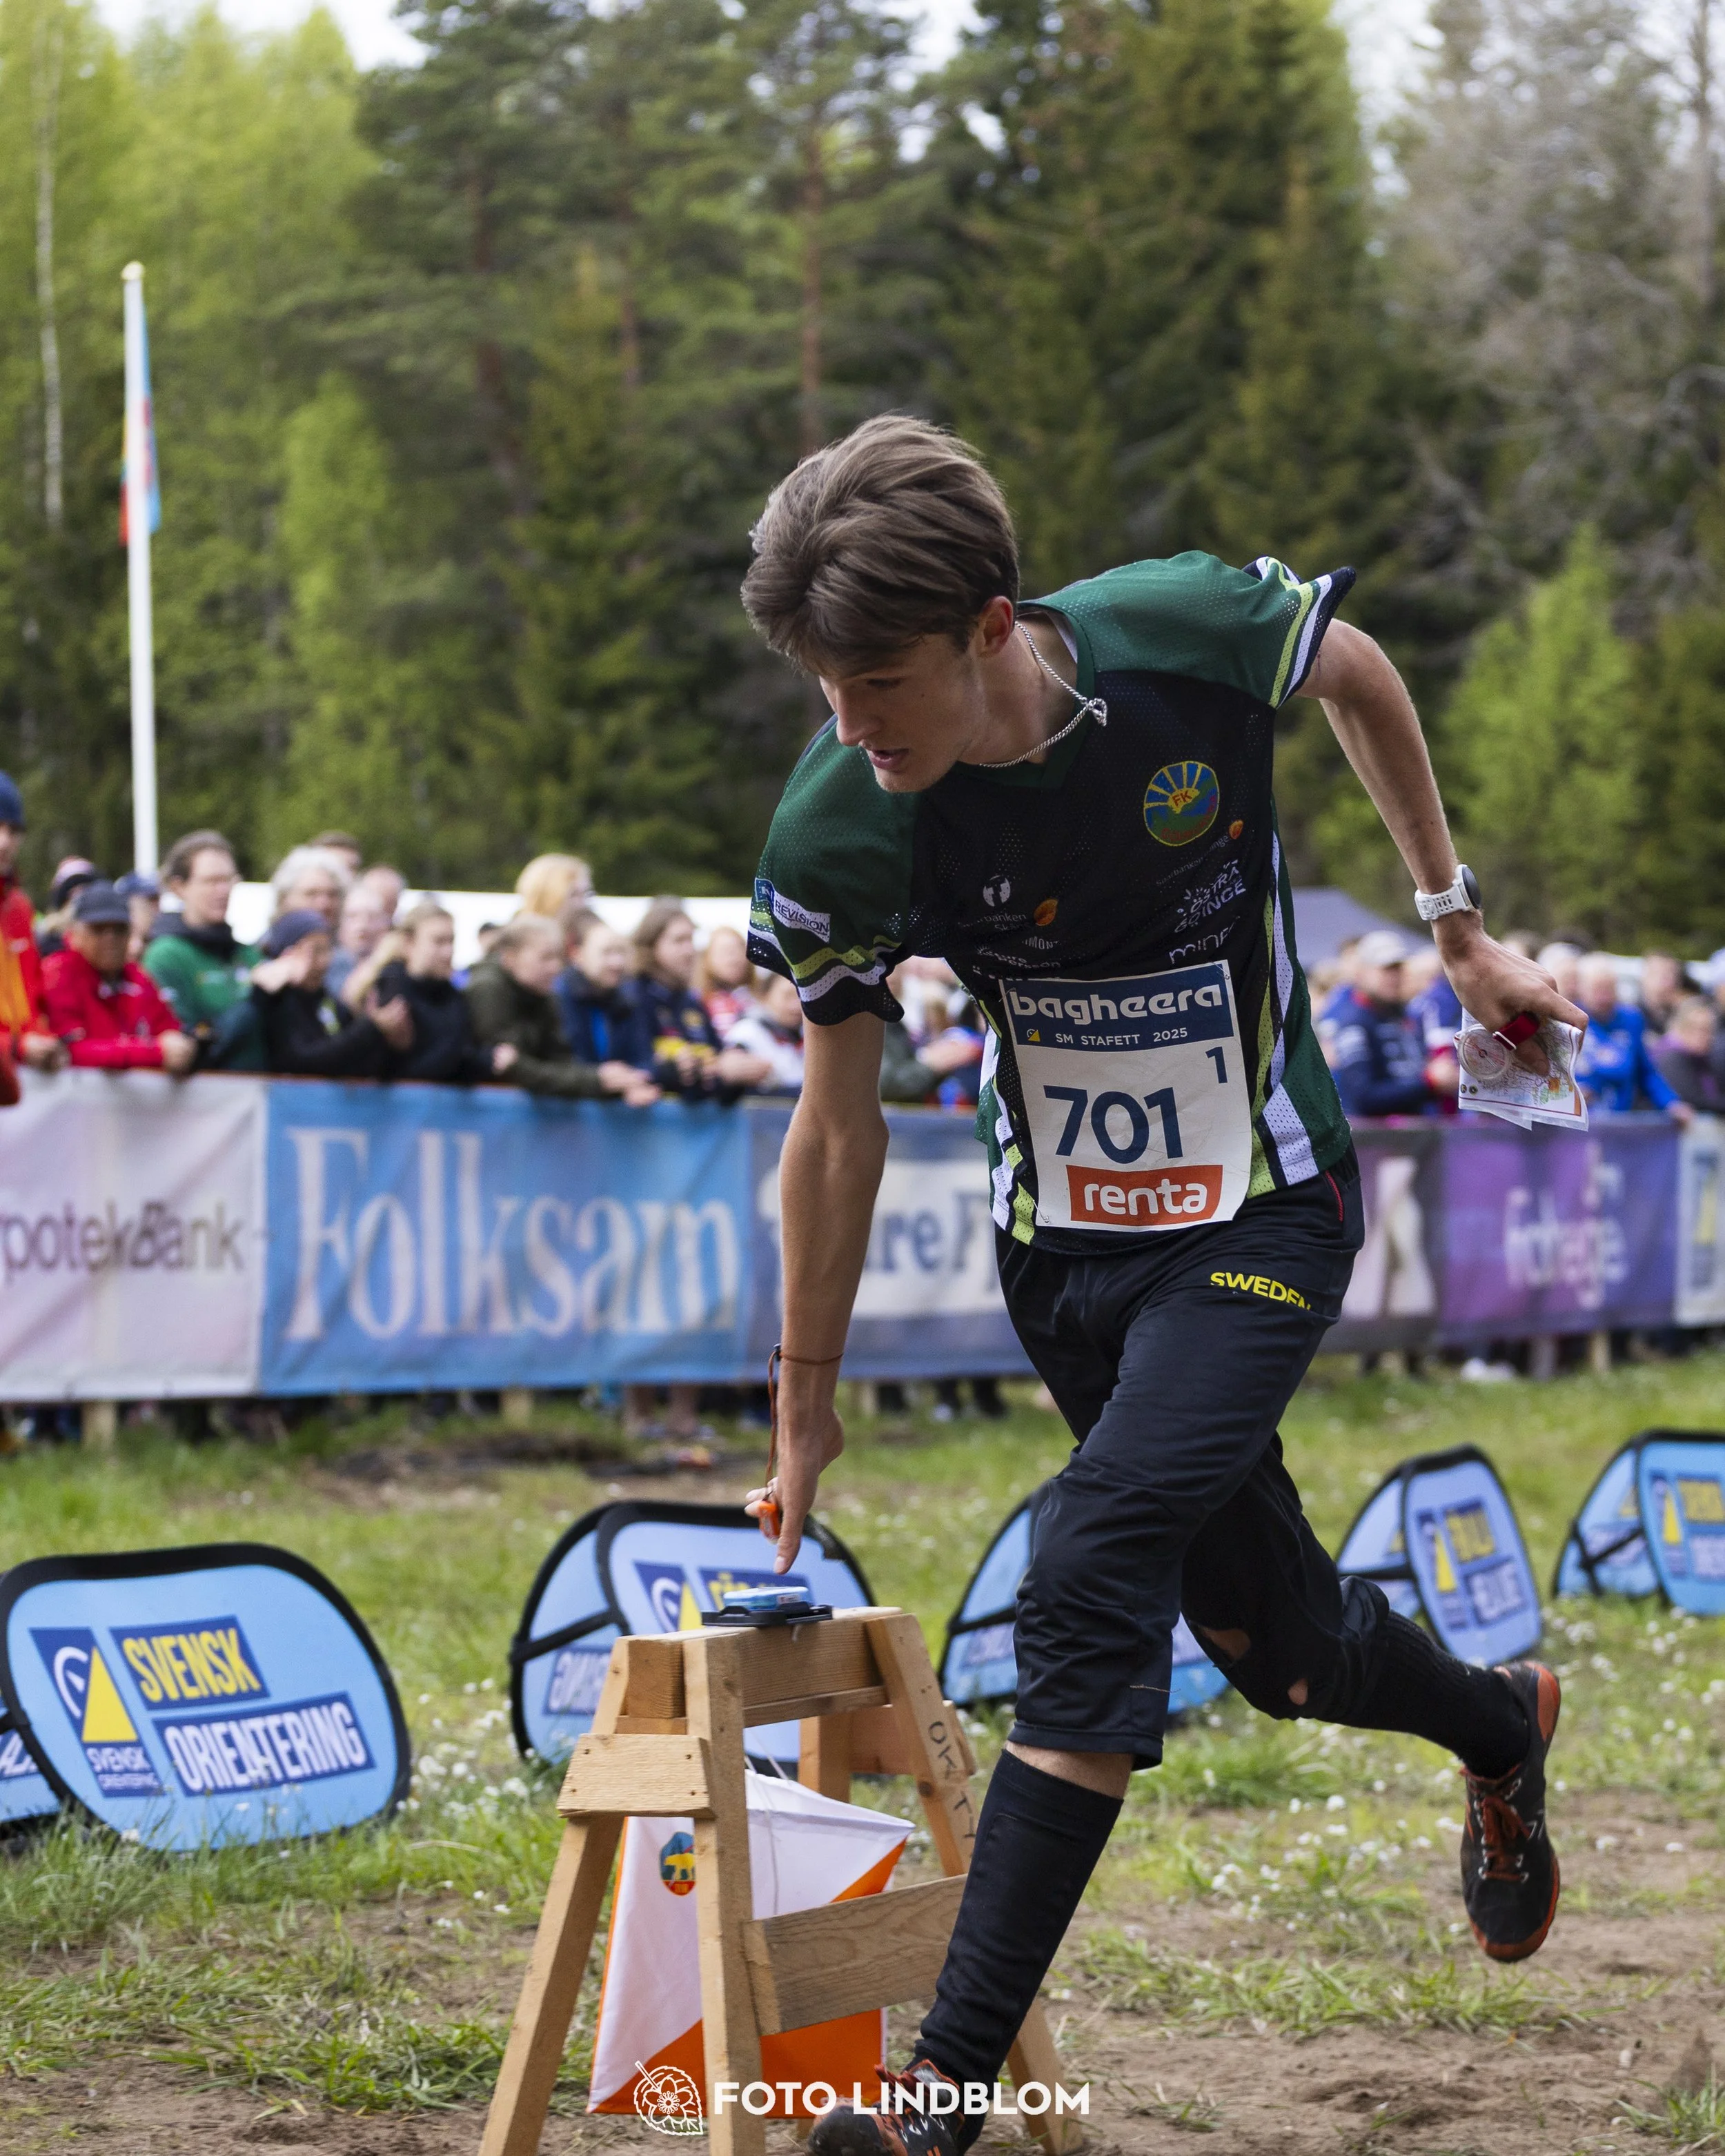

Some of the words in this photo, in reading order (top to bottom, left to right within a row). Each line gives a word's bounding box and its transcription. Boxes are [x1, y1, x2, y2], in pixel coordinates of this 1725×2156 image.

[1172, 791, 1192, 807] FK
[775, 899, 829, 933] REVISION
[1009, 983, 1223, 1025] bagheera
[1055, 1033, 1074, 1044] SM
[1081, 1034, 1141, 1046] STAFETT
[1153, 1027, 1188, 1042] 2025
[1205, 1046, 1228, 1084] 1
[1043, 1085, 1184, 1165] 701
[1083, 1178, 1208, 1216] renta
[285, 1127, 740, 1342] Folksam
[123, 1627, 261, 1702] SVENSK
[163, 1701, 368, 1793] ORIENTERING
